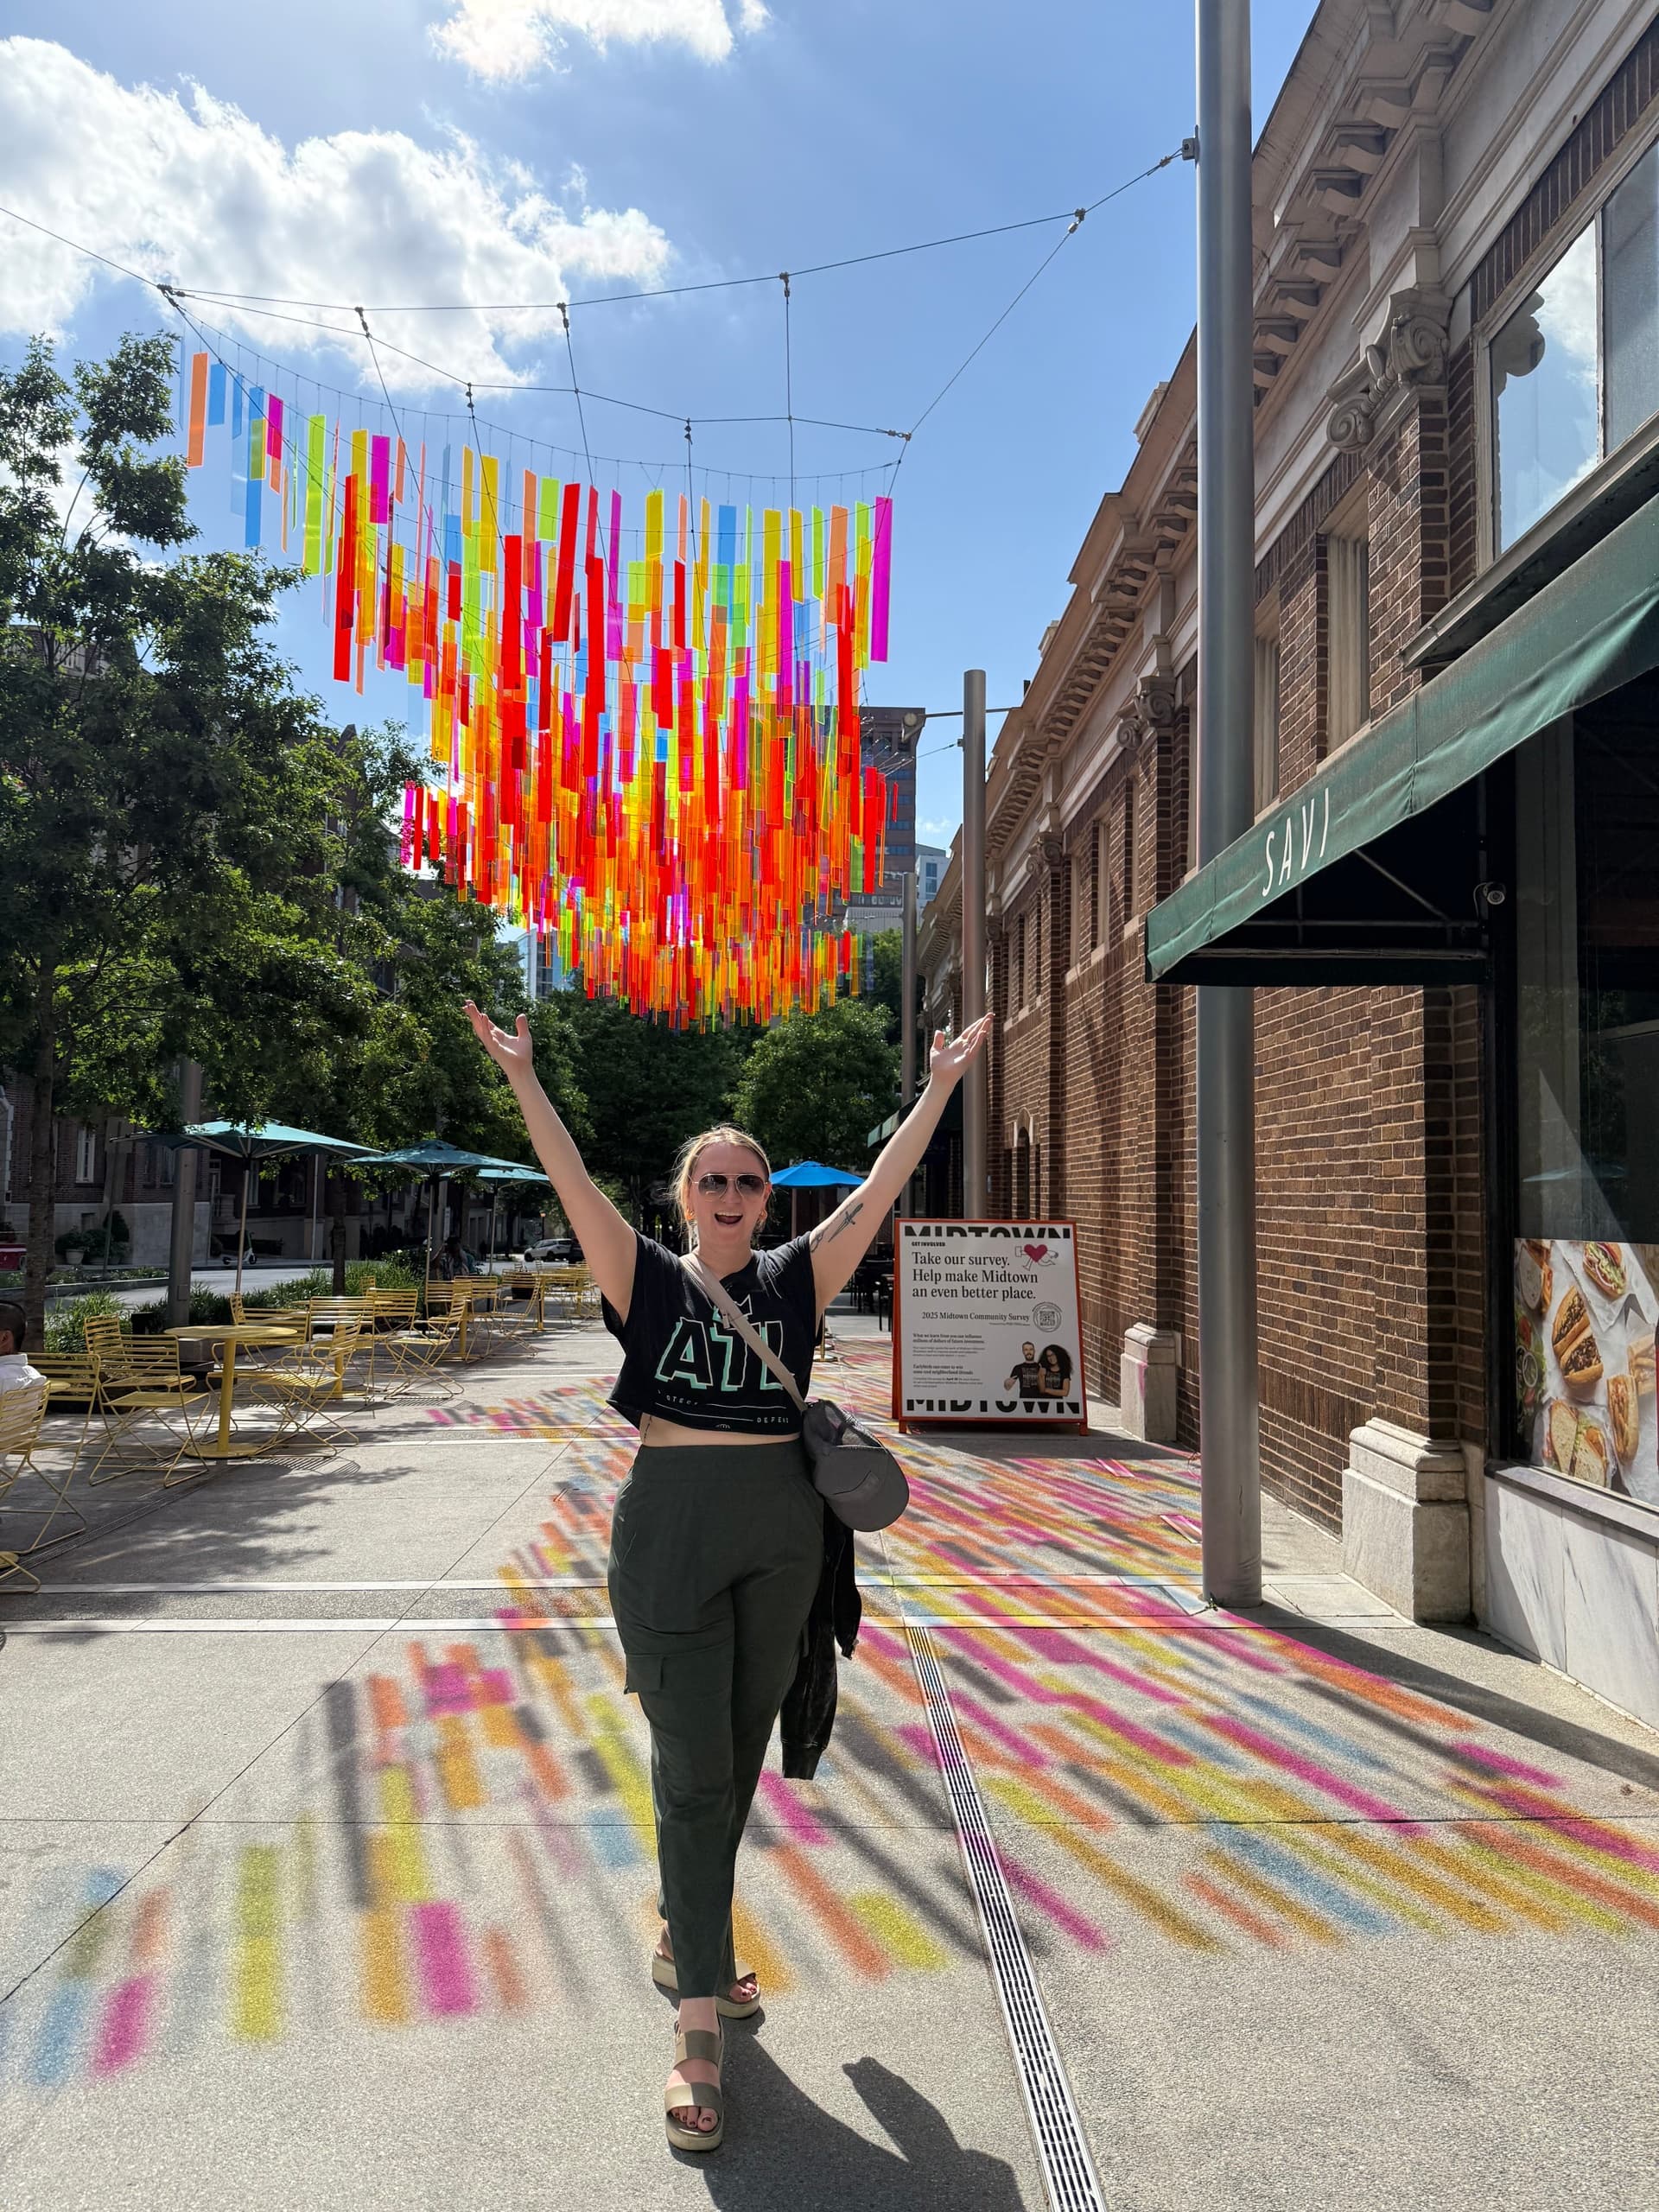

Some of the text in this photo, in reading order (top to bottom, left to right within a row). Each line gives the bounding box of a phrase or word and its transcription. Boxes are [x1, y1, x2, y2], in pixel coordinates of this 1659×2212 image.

[1262, 787, 1329, 897] SAVI
[912, 1252, 1010, 1268] Take our survey.
[912, 1268, 1039, 1284] Help make Midtown
[912, 1286, 1037, 1301] an even better place.
[939, 1312, 969, 1320] Midtown
[969, 1313, 1007, 1322] Community
[1008, 1313, 1030, 1322] Survey
[654, 1316, 785, 1391] ATL
